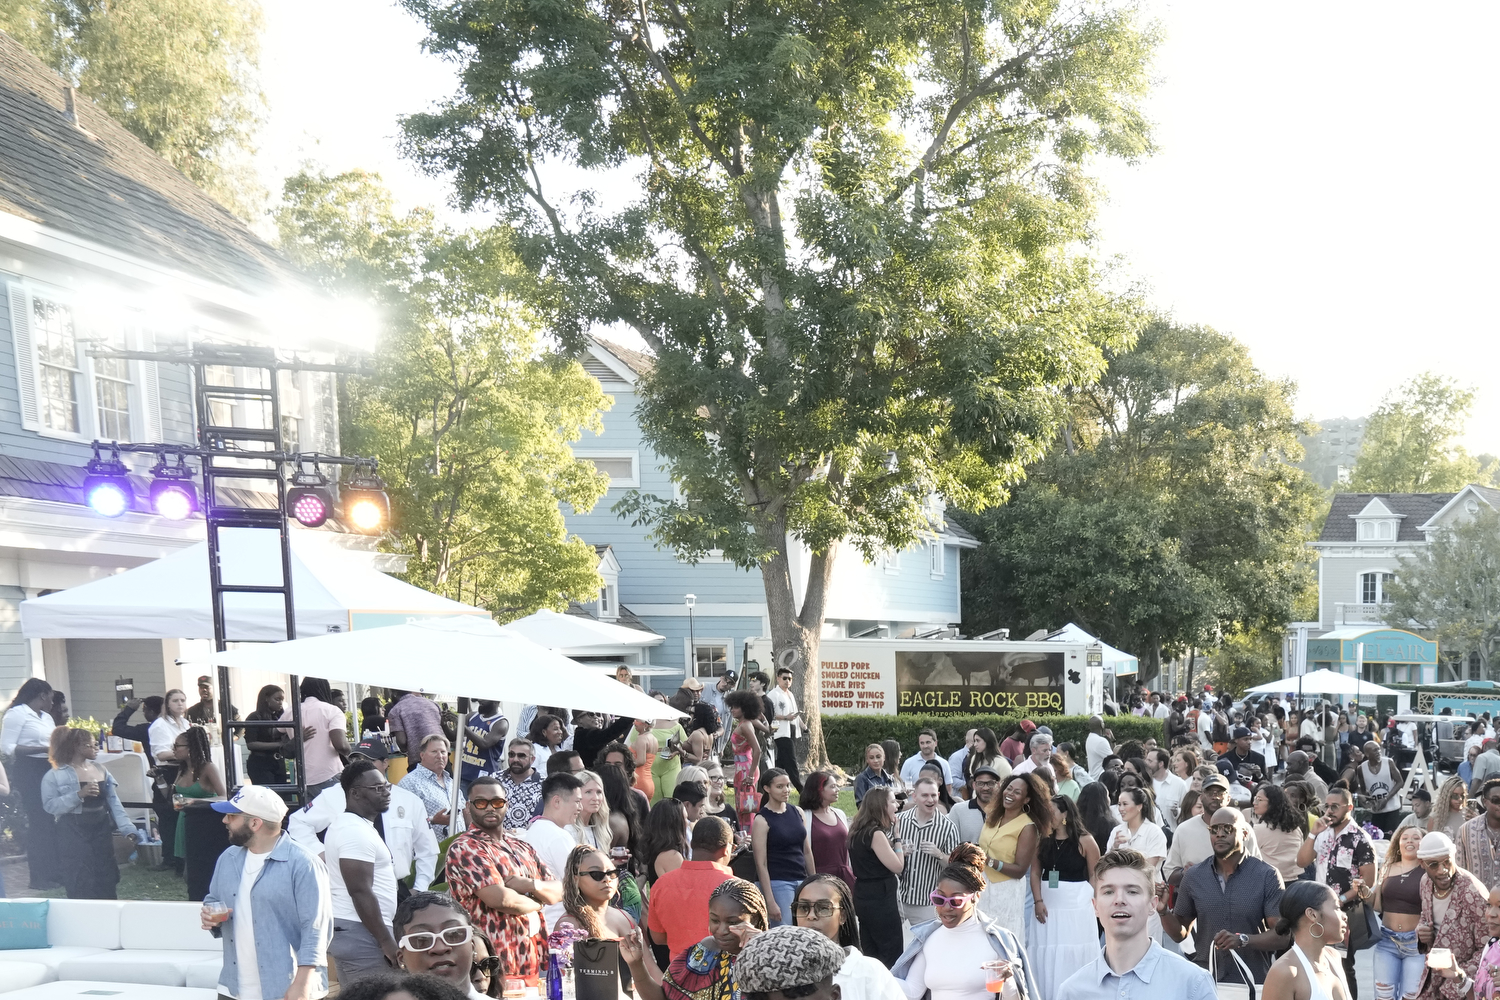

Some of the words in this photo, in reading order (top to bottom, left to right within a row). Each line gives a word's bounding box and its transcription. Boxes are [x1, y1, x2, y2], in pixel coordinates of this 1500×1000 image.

[1393, 644, 1428, 661] AIR
[821, 661, 849, 670] PULLED
[851, 661, 870, 670] PORK
[821, 671, 848, 679] SMOKED
[850, 671, 880, 680] CHICKEN
[821, 680, 845, 689] SPARE
[848, 681, 865, 689] RIBS
[821, 690, 854, 698] SMOKED
[857, 691, 885, 699] WINGS
[821, 700, 854, 708] SMOKED
[856, 701, 885, 709] TRI-TIP
[900, 691, 961, 707] EAGLE
[969, 691, 1019, 708] ROCK
[1025, 692, 1062, 711] BBQ
